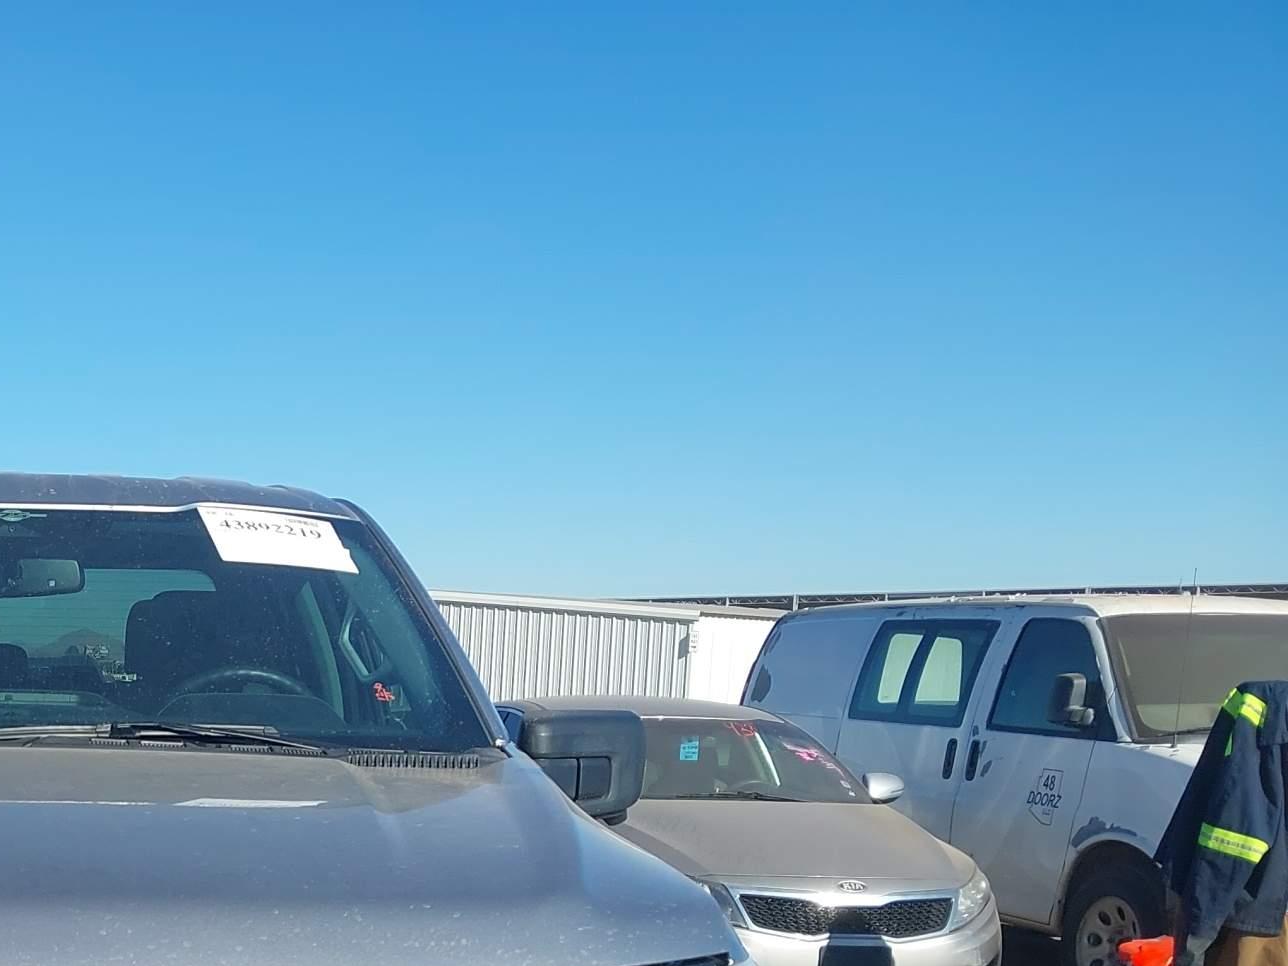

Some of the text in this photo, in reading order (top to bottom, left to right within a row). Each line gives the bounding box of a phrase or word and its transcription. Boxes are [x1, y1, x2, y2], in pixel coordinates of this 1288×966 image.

[1042, 774, 1057, 791] 48
[1026, 790, 1062, 809] DOORZ
[841, 882, 865, 891] KIA
